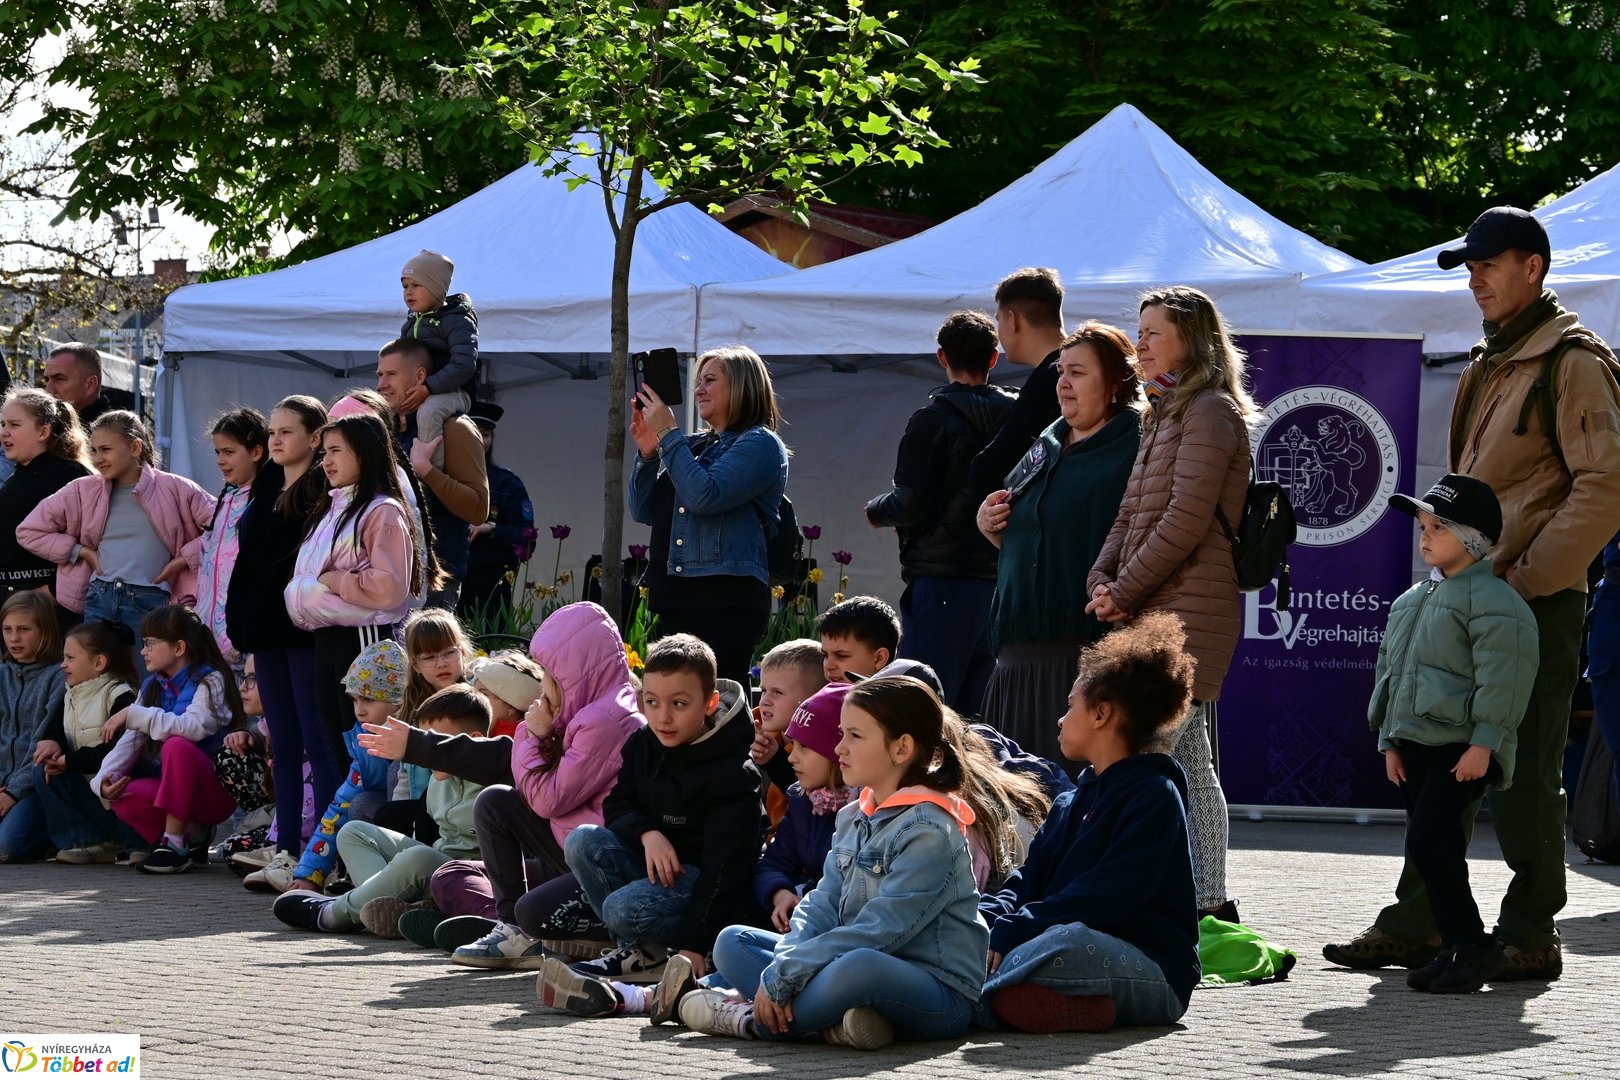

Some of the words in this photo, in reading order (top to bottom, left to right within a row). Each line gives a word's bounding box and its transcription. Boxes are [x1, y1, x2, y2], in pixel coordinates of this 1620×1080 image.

[1306, 526, 1355, 541] PRISON
[1360, 479, 1393, 526] SERVICE
[1308, 516, 1329, 526] 1878
[1242, 656, 1259, 666] Az
[1264, 656, 1310, 671] igazság
[791, 708, 816, 728] KYE
